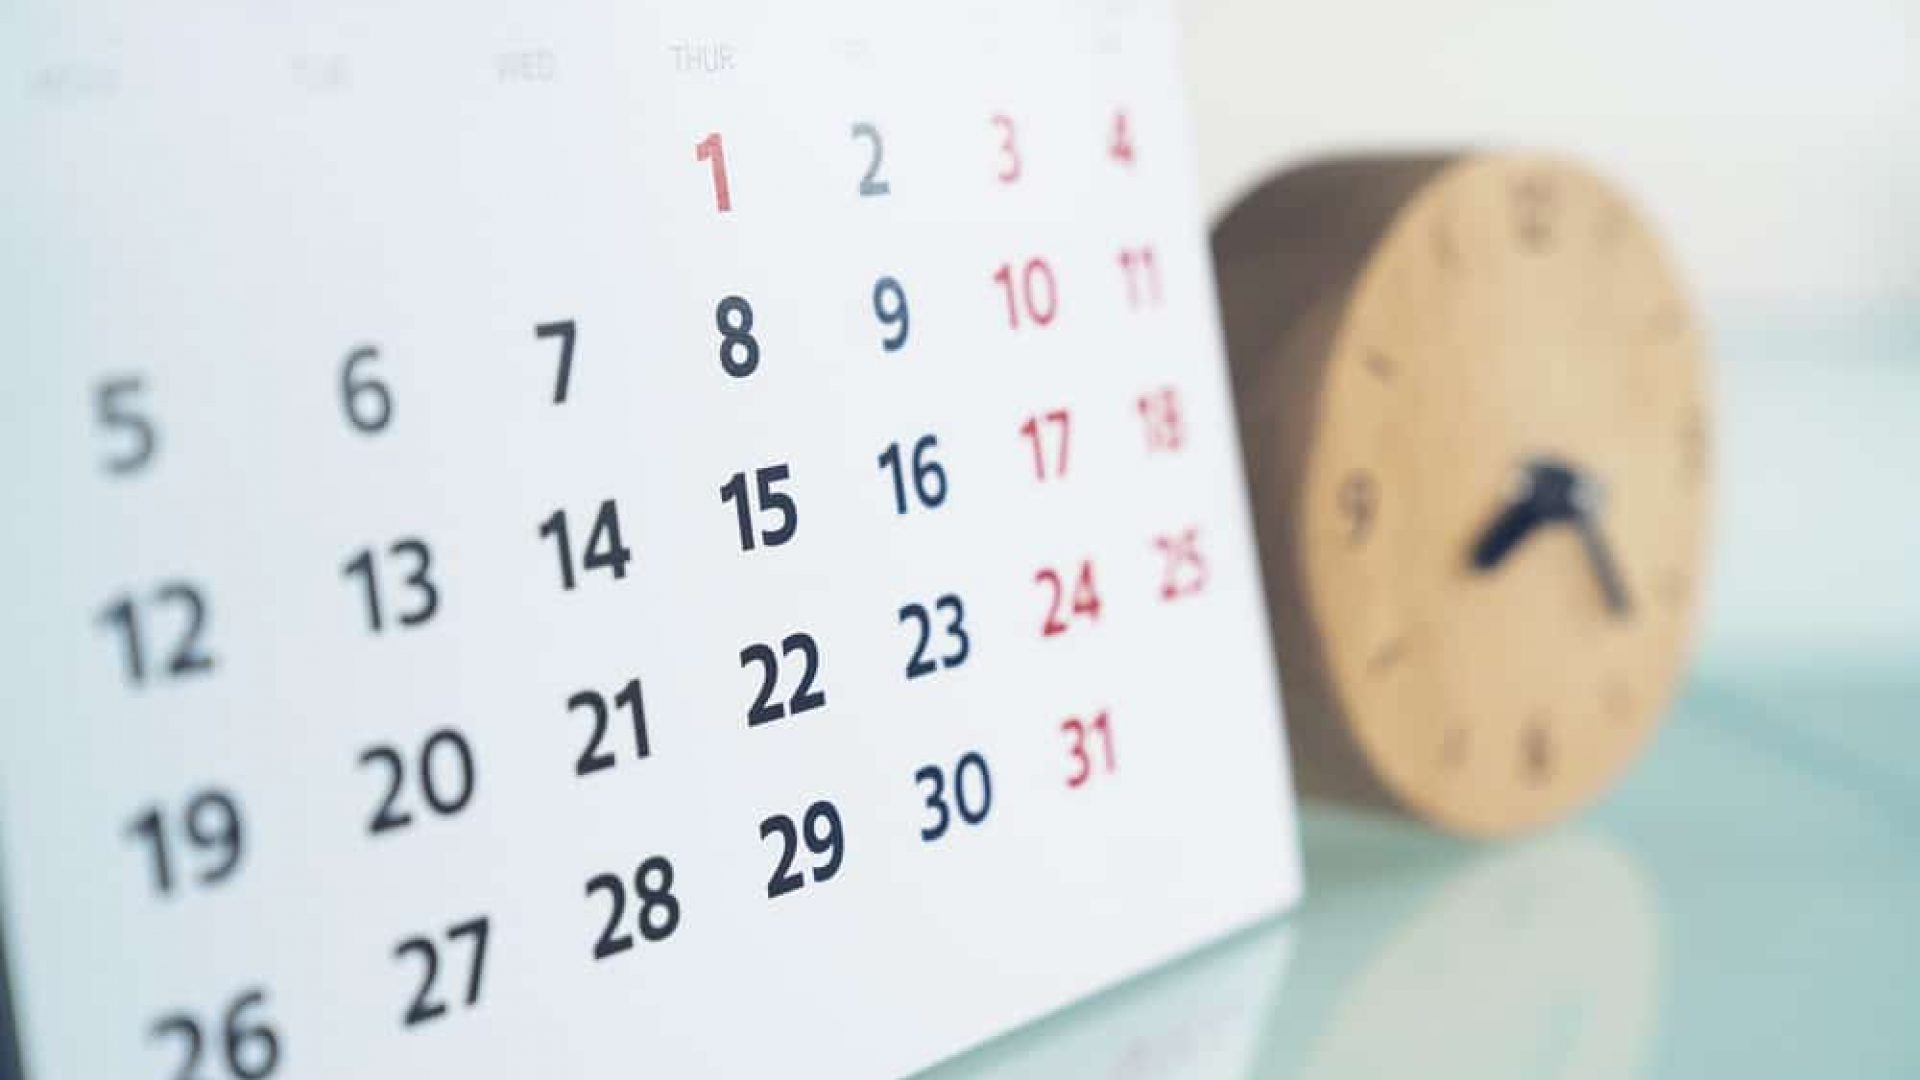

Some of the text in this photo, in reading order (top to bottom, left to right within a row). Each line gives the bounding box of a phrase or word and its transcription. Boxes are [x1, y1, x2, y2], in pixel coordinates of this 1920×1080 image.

[496, 50, 556, 82] WED
[671, 42, 736, 72] THUR
[696, 108, 1137, 212] 1 2 3 4
[94, 246, 1163, 475] 5 6 7 8 9 10 11
[98, 584, 217, 686] 12
[342, 537, 440, 634] 13
[538, 499, 631, 591] 14
[720, 463, 798, 551] 15
[877, 434, 948, 515] 16
[1018, 407, 1072, 482] 17
[125, 528, 1208, 897] 19 20 21 22 23 24 25
[148, 709, 1116, 1080] 26 27 28 29 30 31
